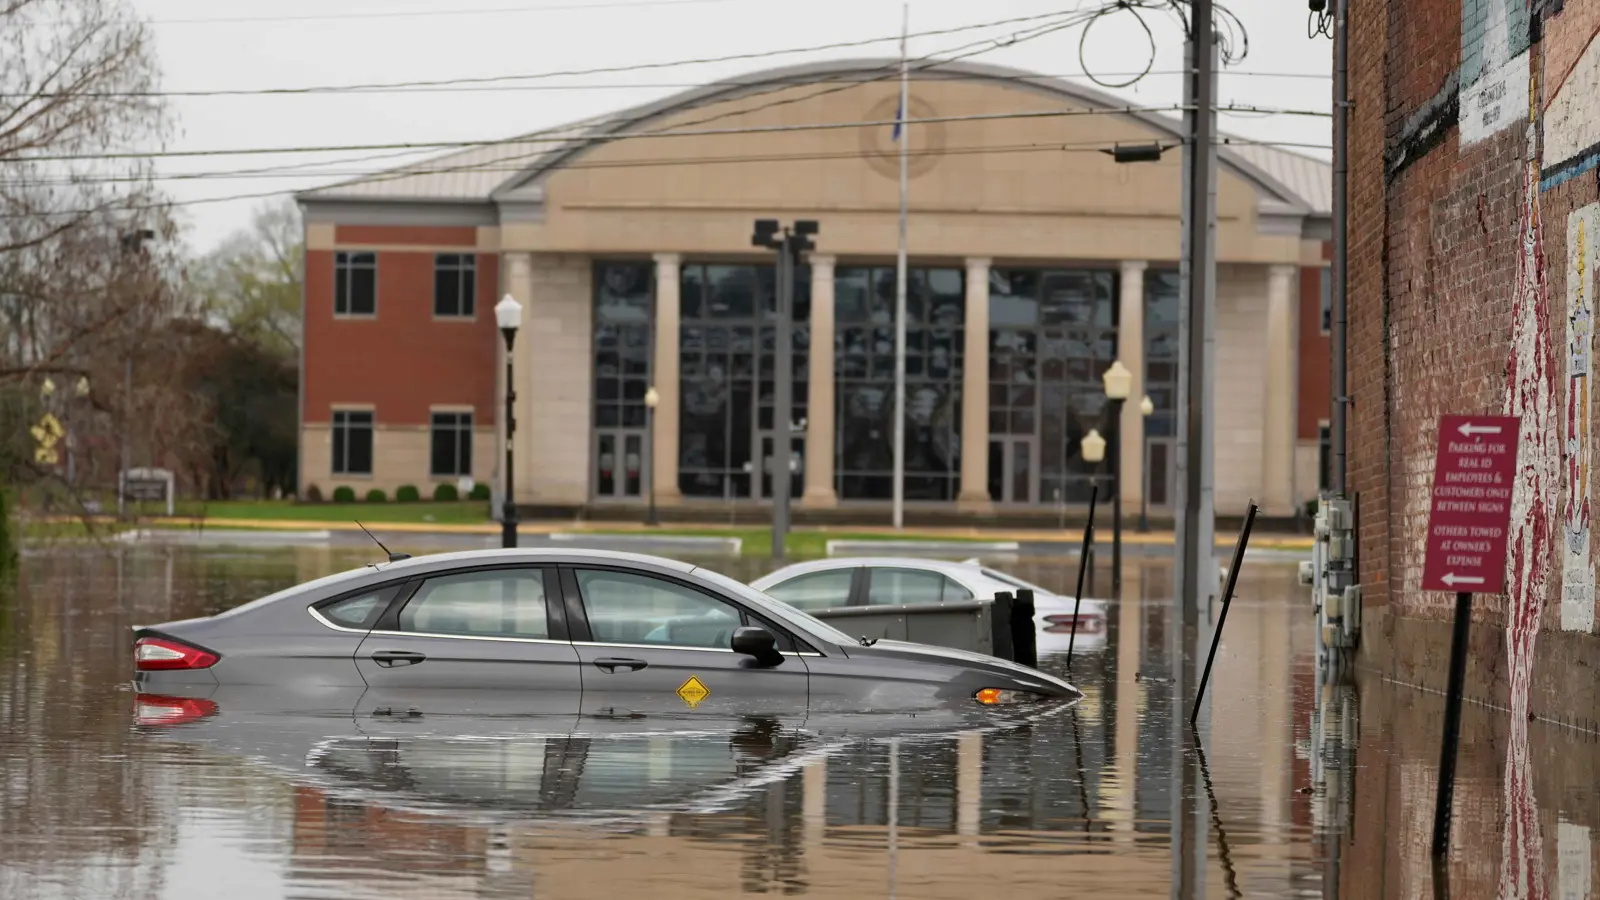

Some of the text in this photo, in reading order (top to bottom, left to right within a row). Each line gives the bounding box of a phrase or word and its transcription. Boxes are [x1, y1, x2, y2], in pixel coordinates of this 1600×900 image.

[1448, 441, 1506, 454] PARKING FOR
[1458, 457, 1493, 468] REAL ID
[1445, 471, 1502, 483] EMPLOYEES &
[1434, 485, 1509, 498] CUSTOMERS ONLY
[1436, 500, 1504, 513] BETWEEN SIGNS
[1433, 525, 1502, 538] OTHERS TOWED
[1440, 540, 1452, 551] AT
[1446, 555, 1482, 567] EXPENSE
